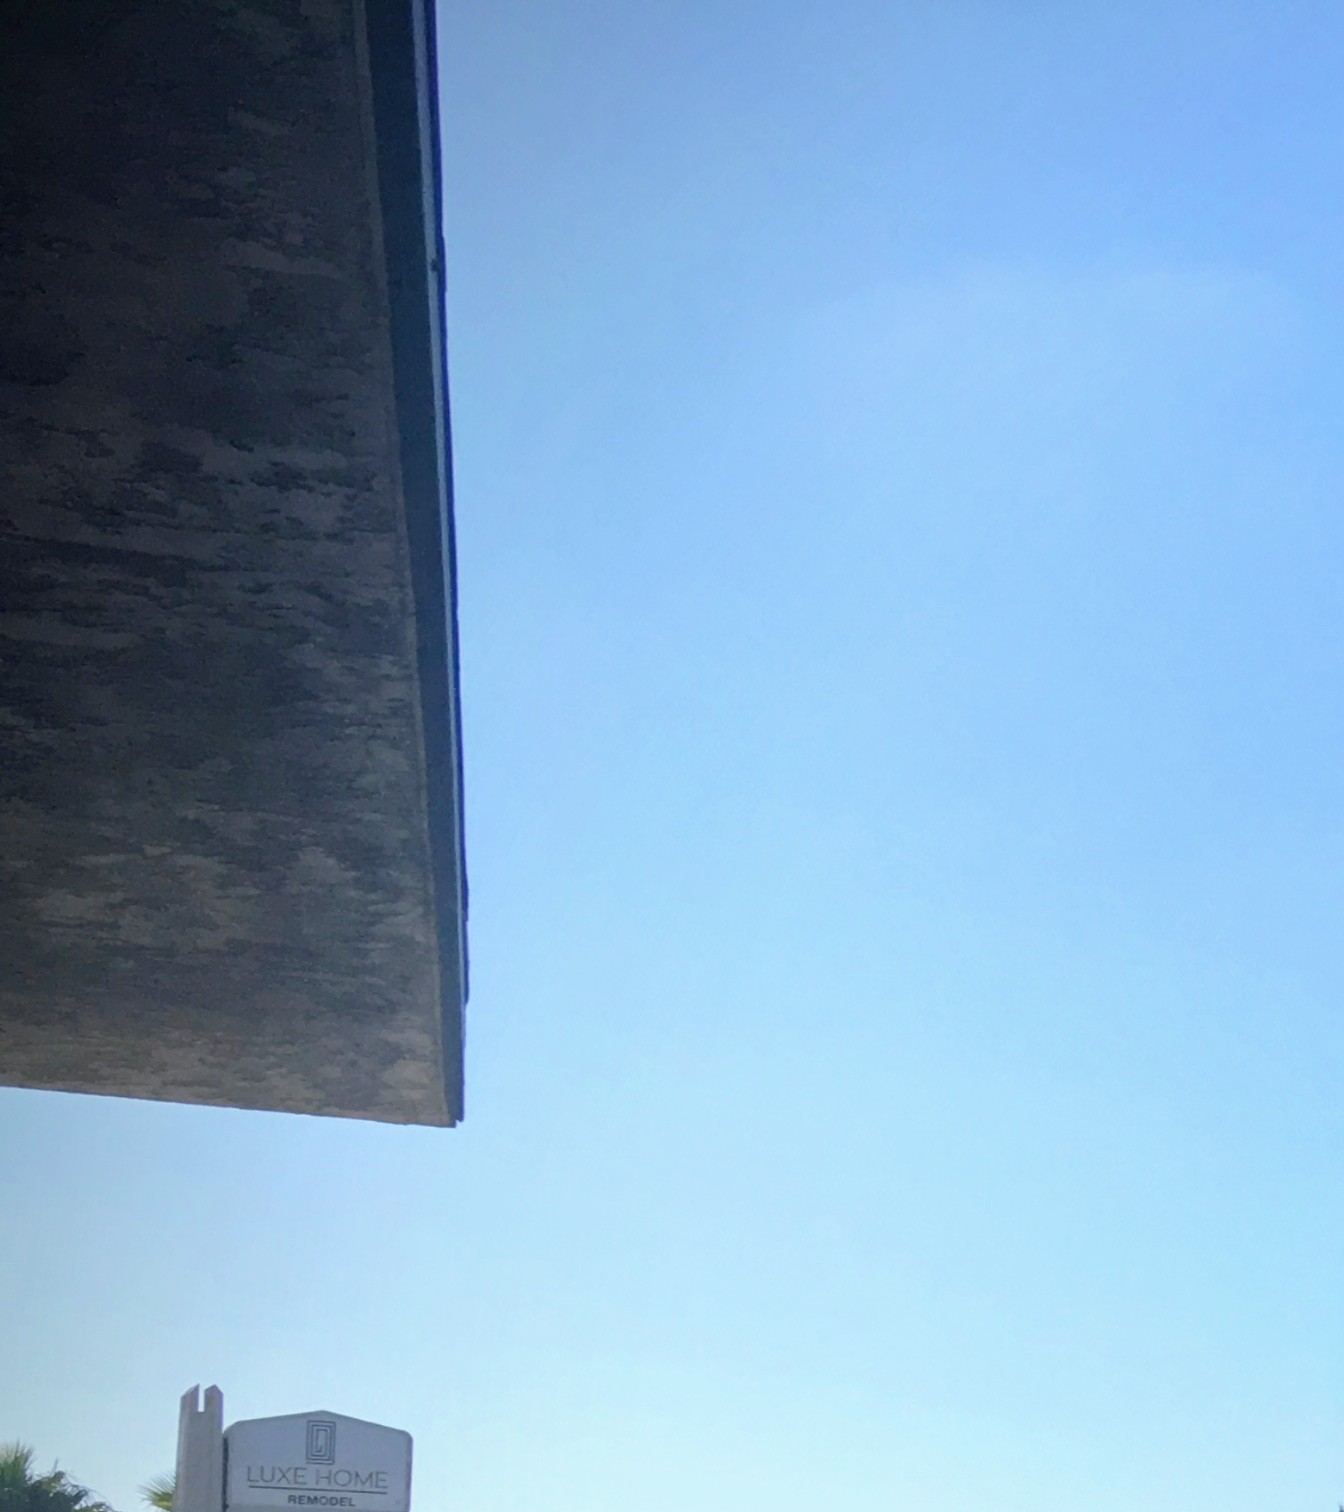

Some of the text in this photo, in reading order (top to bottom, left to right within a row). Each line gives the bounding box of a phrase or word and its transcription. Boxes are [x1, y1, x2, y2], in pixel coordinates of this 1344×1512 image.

[246, 1465, 388, 1489] LUXE HOME
[287, 1494, 356, 1507] REMODEL
